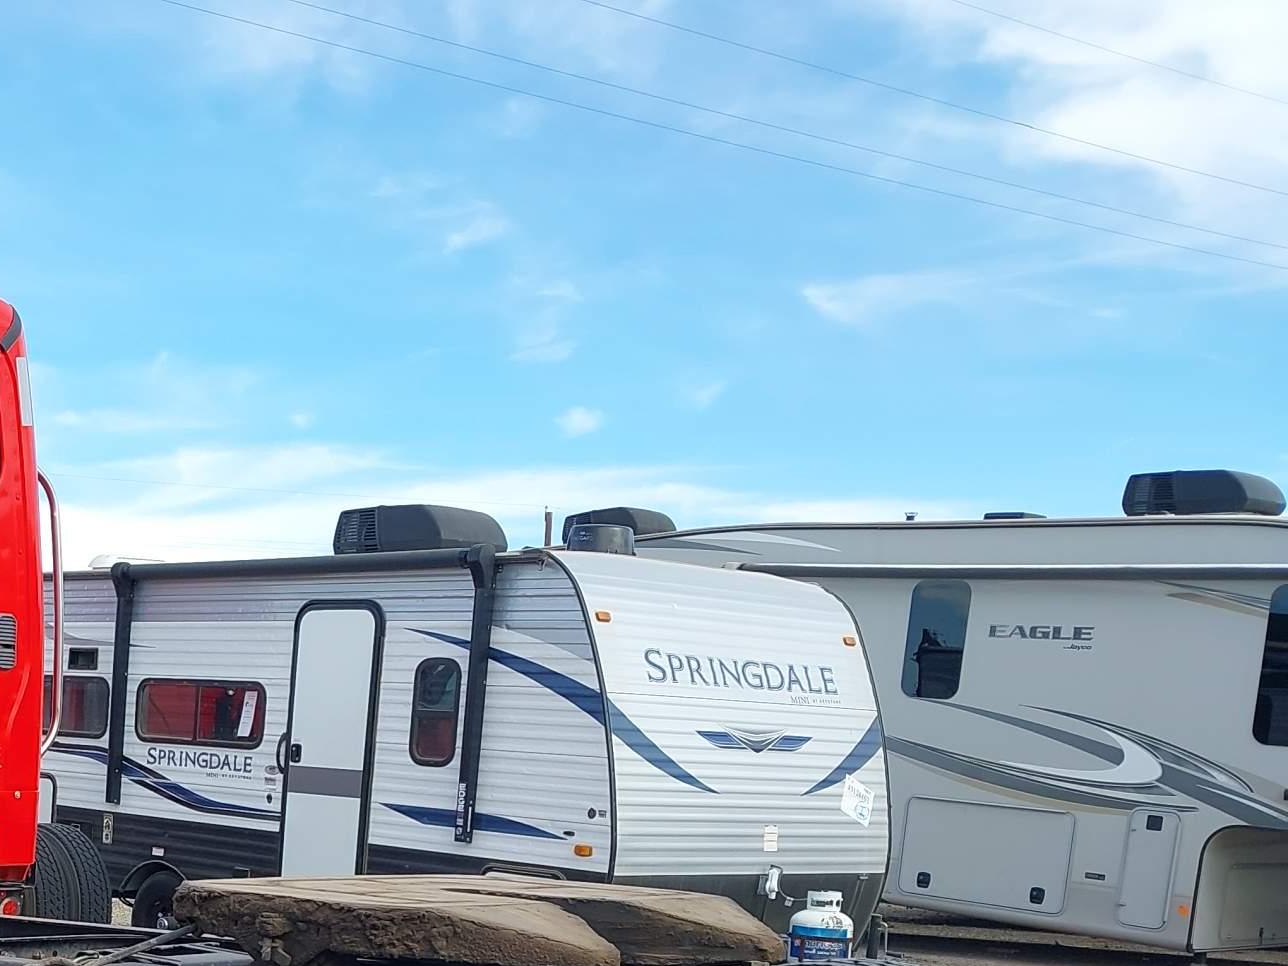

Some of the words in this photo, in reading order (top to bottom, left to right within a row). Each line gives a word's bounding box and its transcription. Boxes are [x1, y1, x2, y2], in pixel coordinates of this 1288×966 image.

[988, 624, 1095, 641] EAGLE
[643, 648, 839, 695] SPRINGDALE
[147, 747, 253, 773] SPRINGDALE
